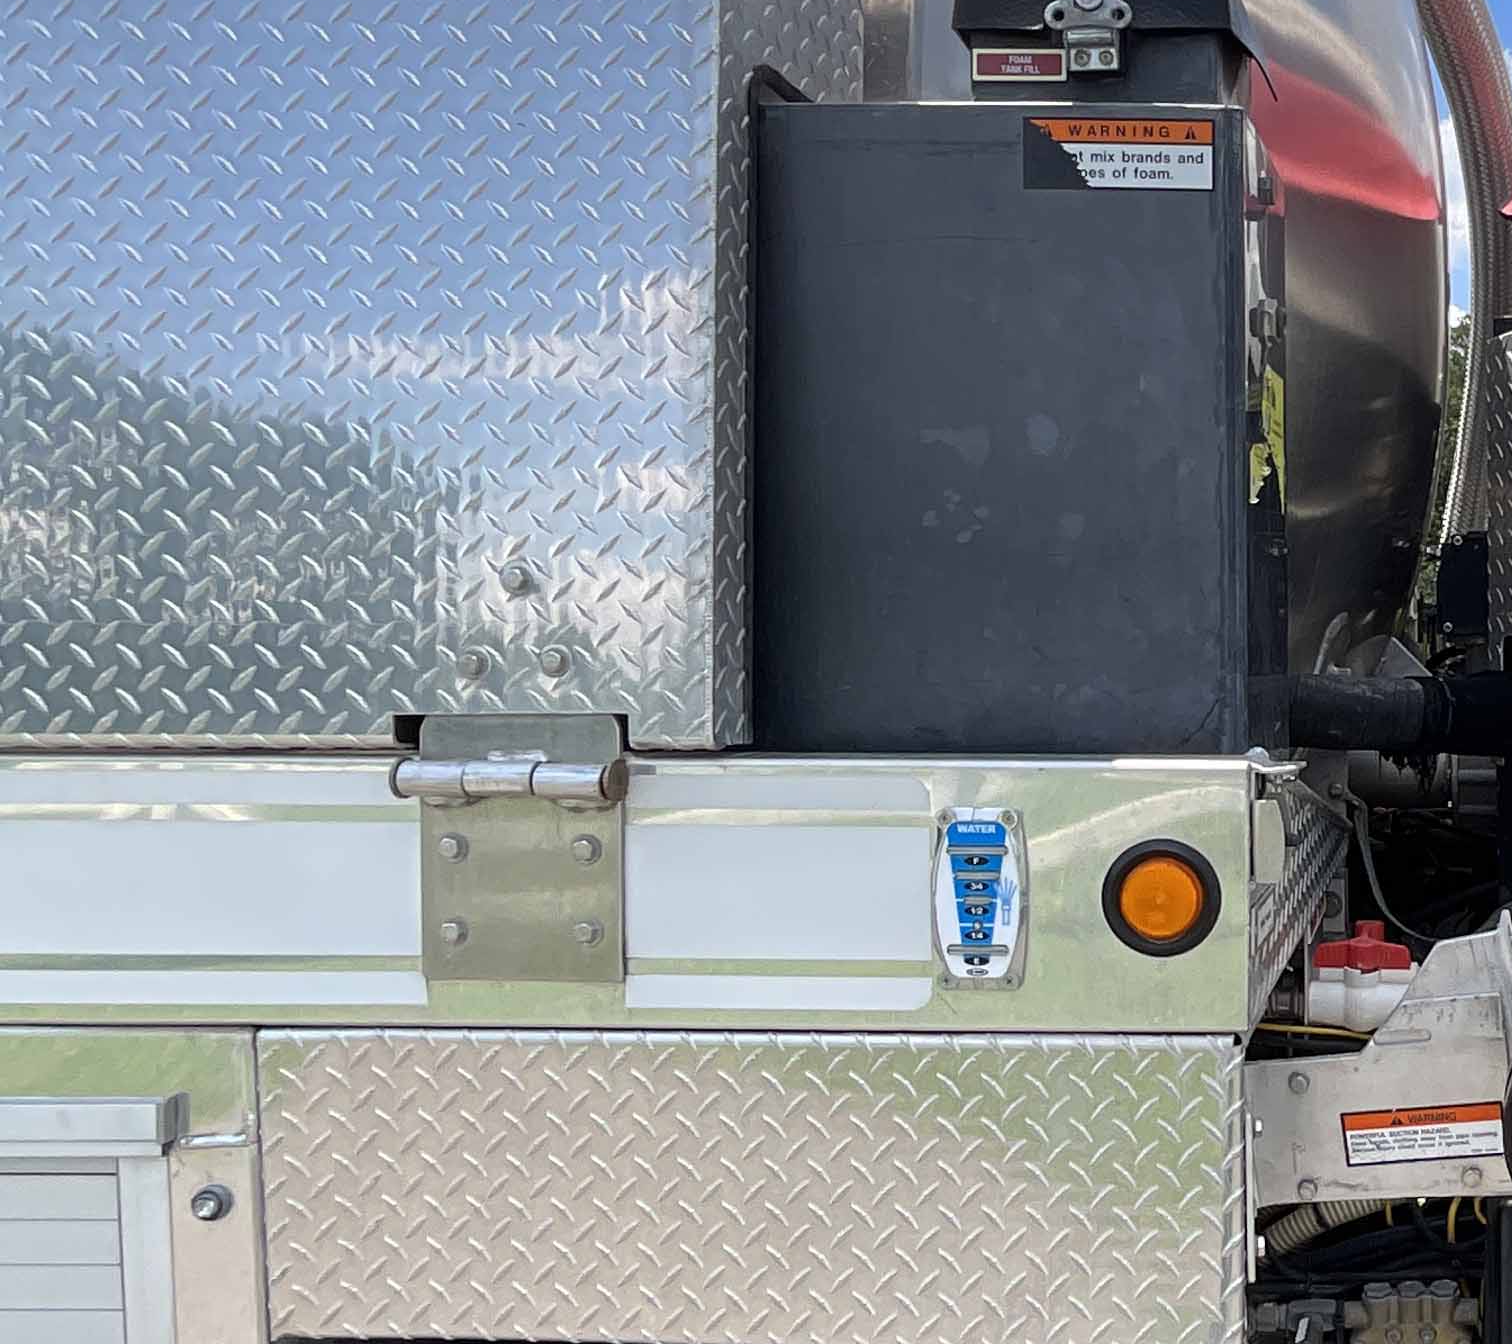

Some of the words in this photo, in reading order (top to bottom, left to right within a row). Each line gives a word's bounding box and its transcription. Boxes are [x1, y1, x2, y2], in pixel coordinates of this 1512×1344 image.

[1008, 55, 1032, 64] FOAM
[1000, 65, 1023, 73] TANK
[1024, 65, 1040, 74] FILL
[1068, 125, 1170, 137] WARNING
[1090, 151, 1115, 163] mix
[1122, 151, 1171, 163] brands
[1178, 152, 1204, 164] and
[1112, 167, 1127, 179] of
[1134, 167, 1174, 180] foam.
[956, 823, 996, 834] WATER
[1407, 1112, 1457, 1122] WARNING
